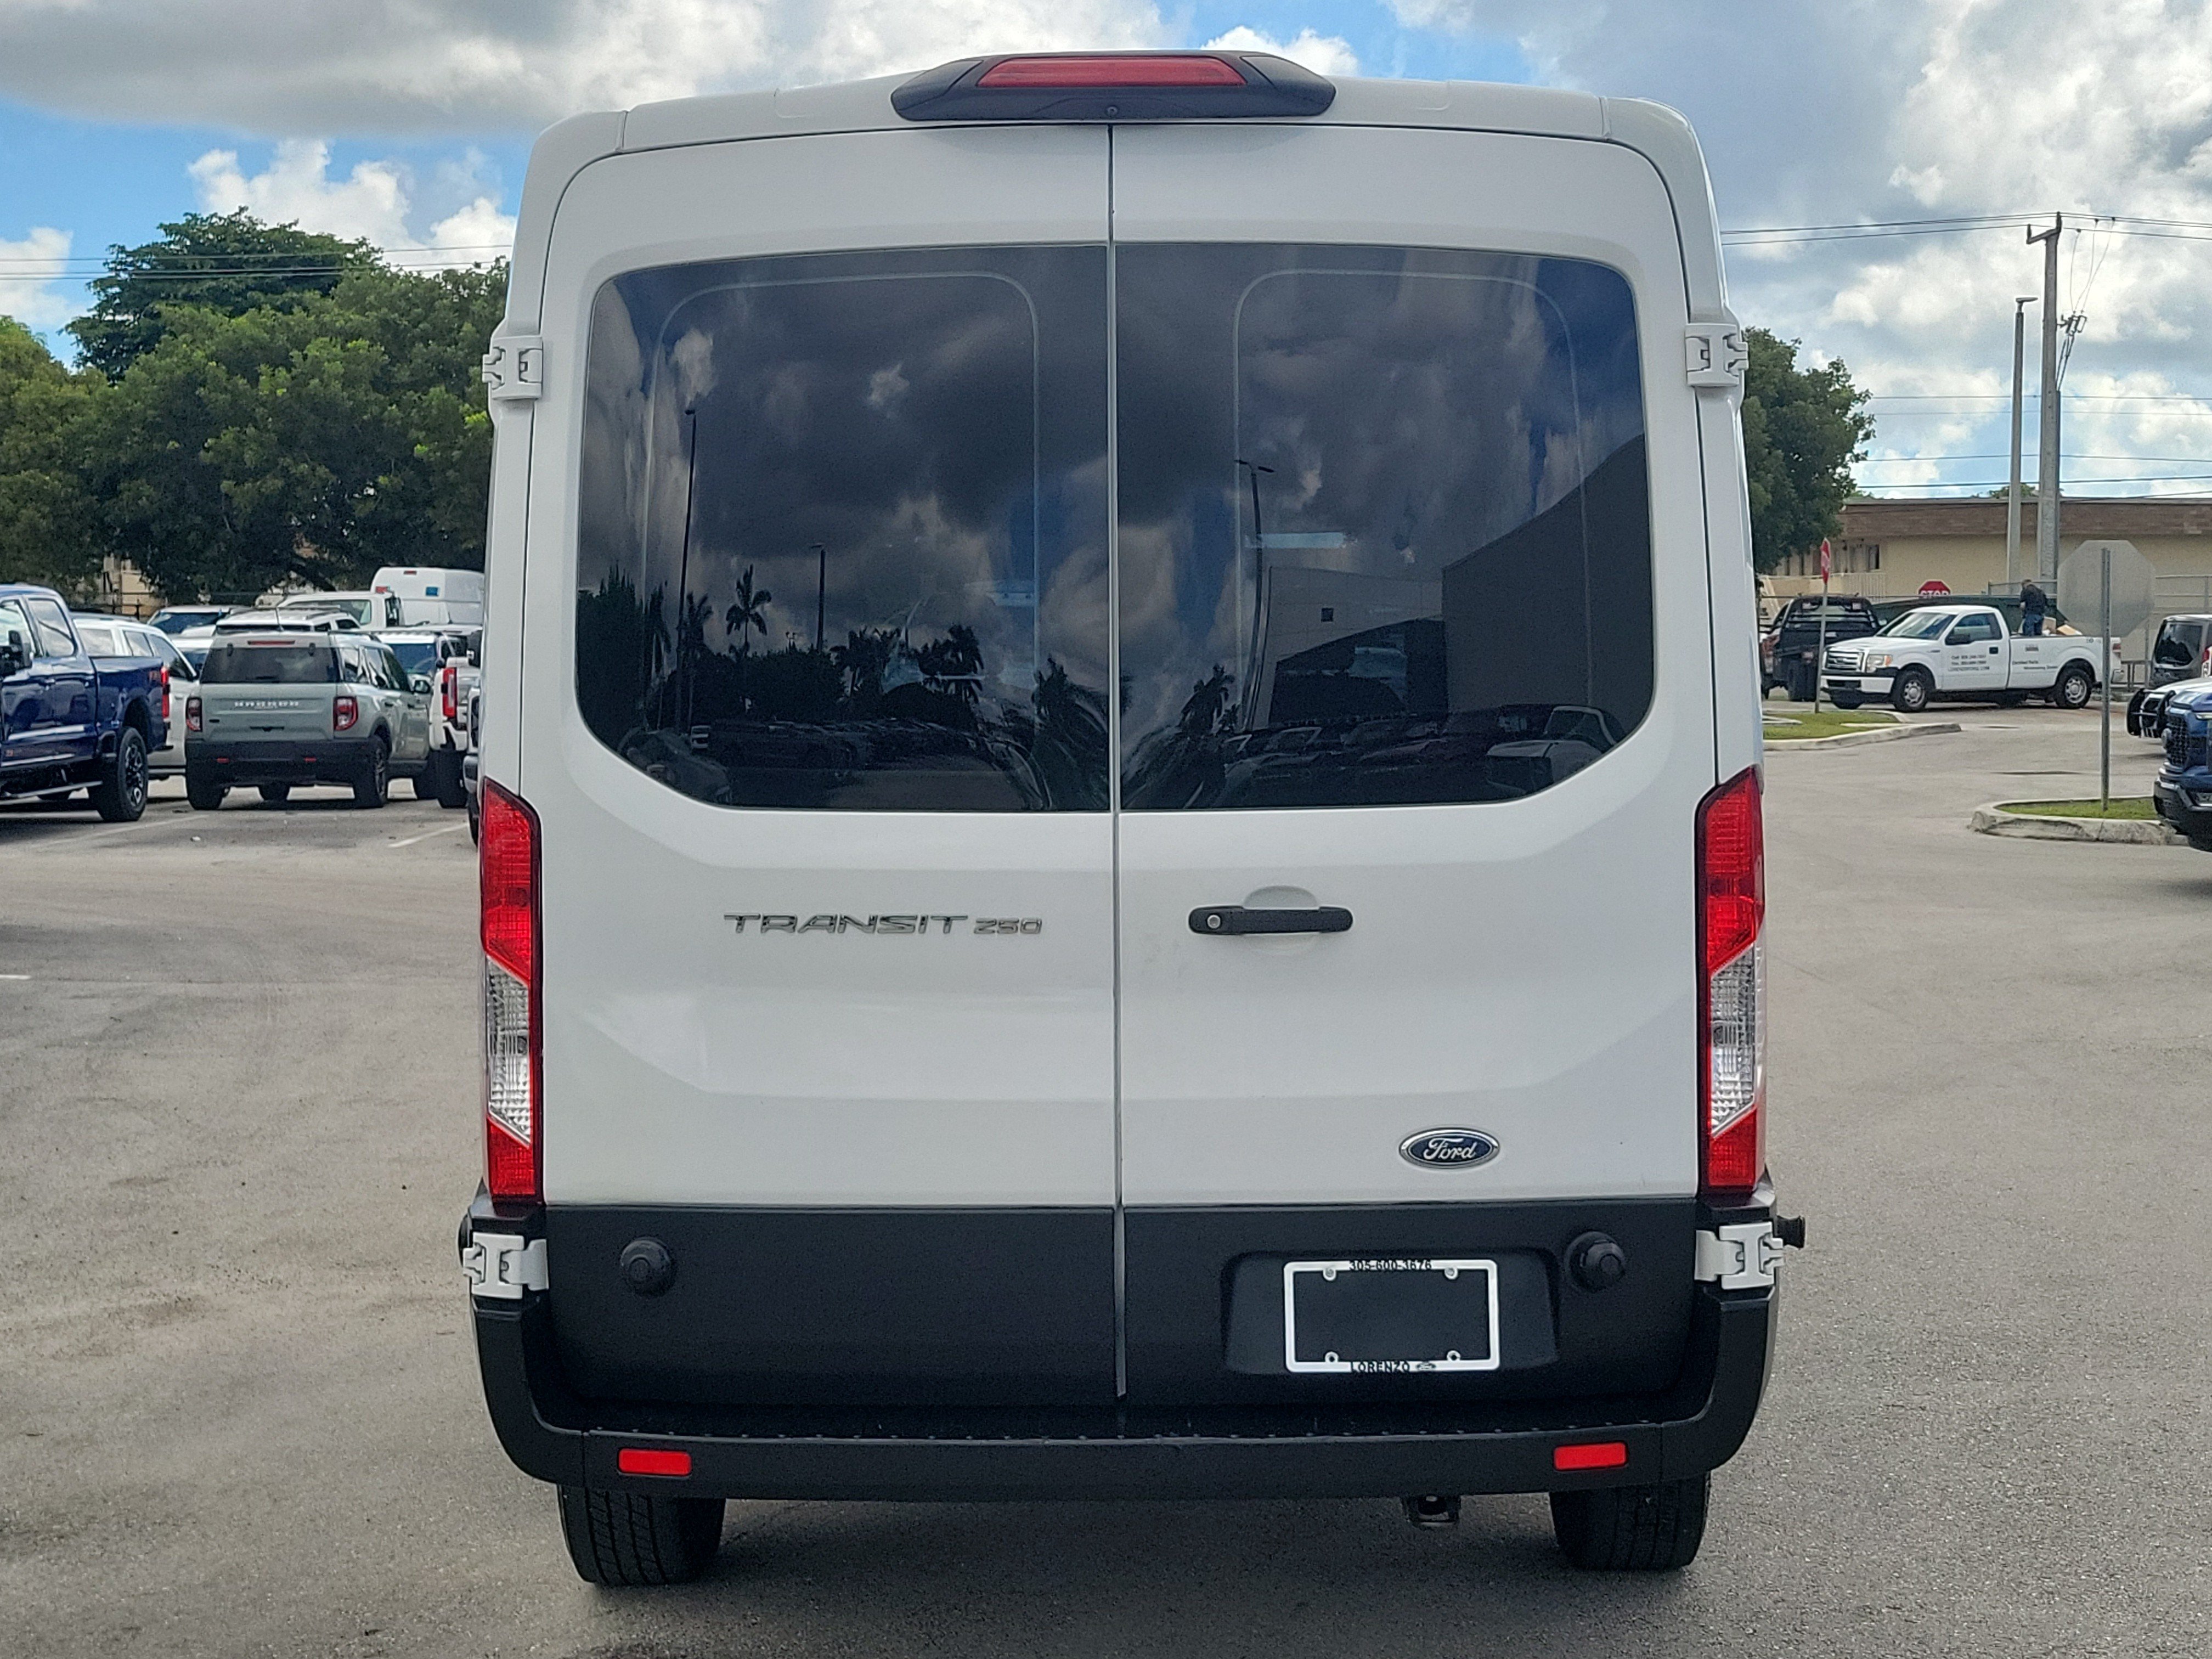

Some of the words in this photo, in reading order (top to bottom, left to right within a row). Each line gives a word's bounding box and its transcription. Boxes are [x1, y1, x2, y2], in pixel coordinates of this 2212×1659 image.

[723, 913, 969, 934] TRANSIT
[973, 917, 1043, 935] 250
[1423, 1137, 1477, 1160] Ford
[1351, 1361, 1410, 1373] LORENZO
